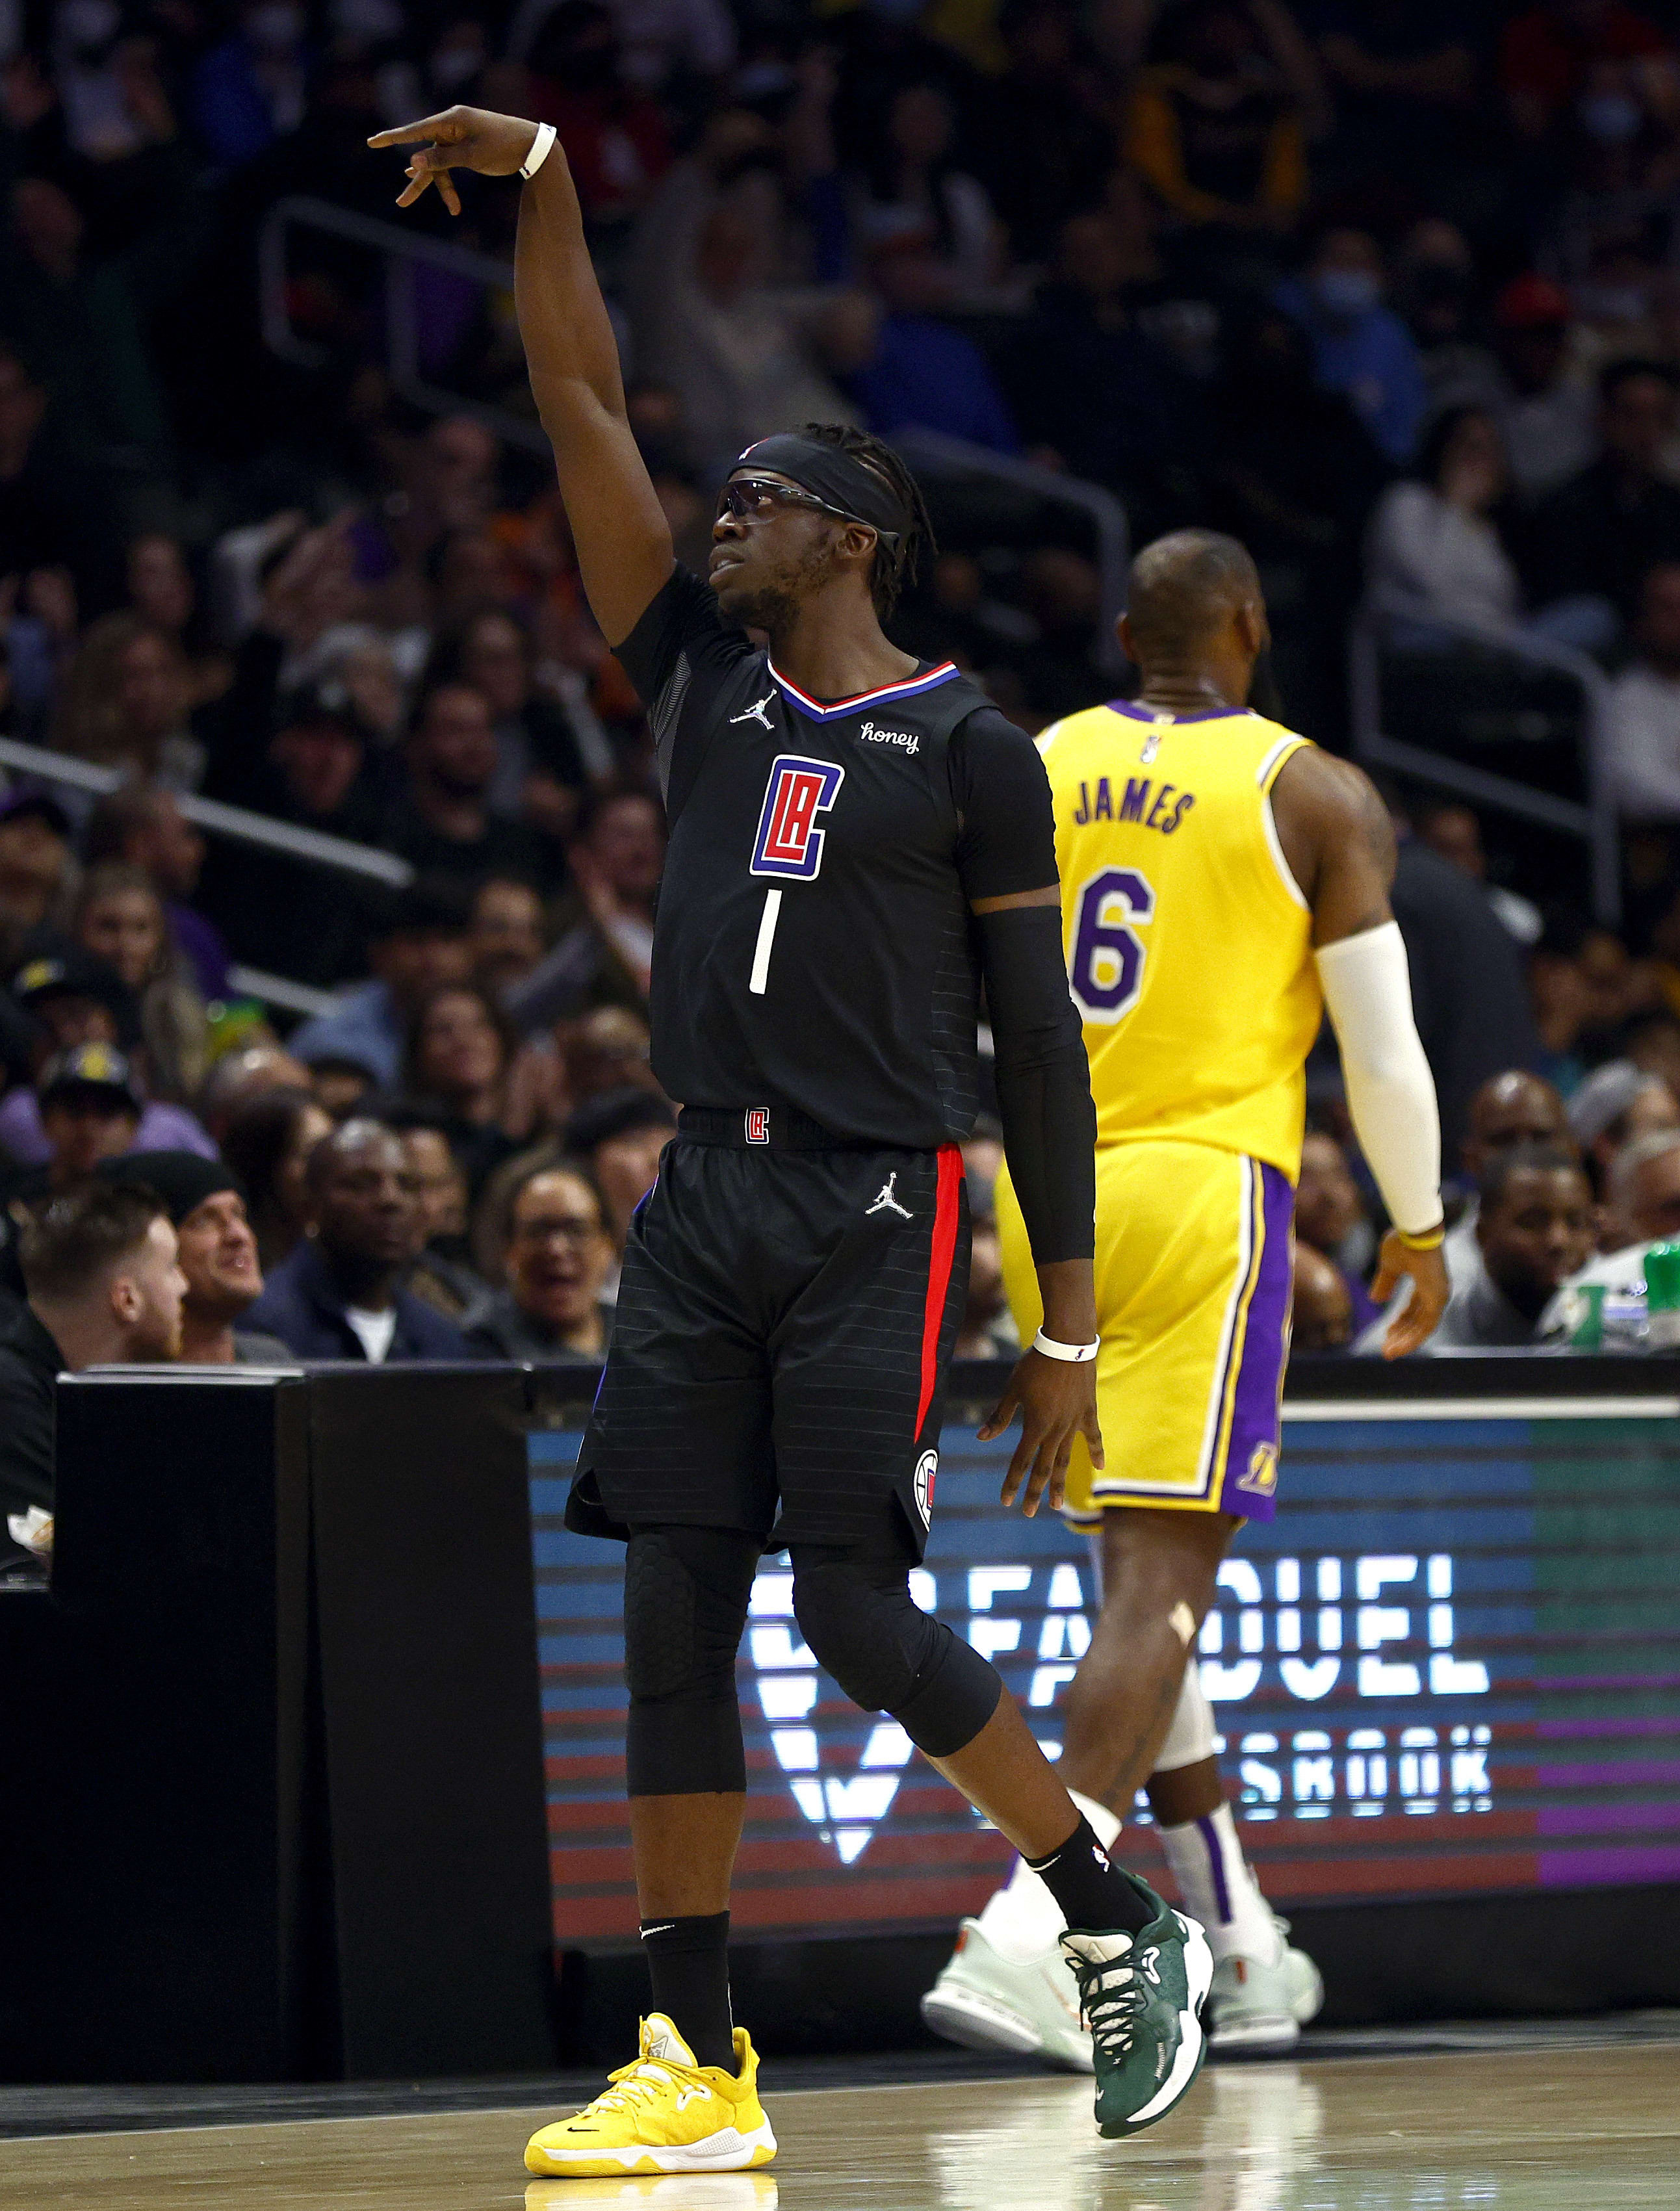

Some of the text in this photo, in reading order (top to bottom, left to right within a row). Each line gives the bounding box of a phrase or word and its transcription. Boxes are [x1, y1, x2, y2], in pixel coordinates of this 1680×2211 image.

[860, 722, 920, 755] honey
[1073, 775, 1196, 834] JAMES
[749, 888, 782, 995] 1
[1069, 864, 1157, 1026] 6
[967, 1553, 1490, 1707] FADUEL
